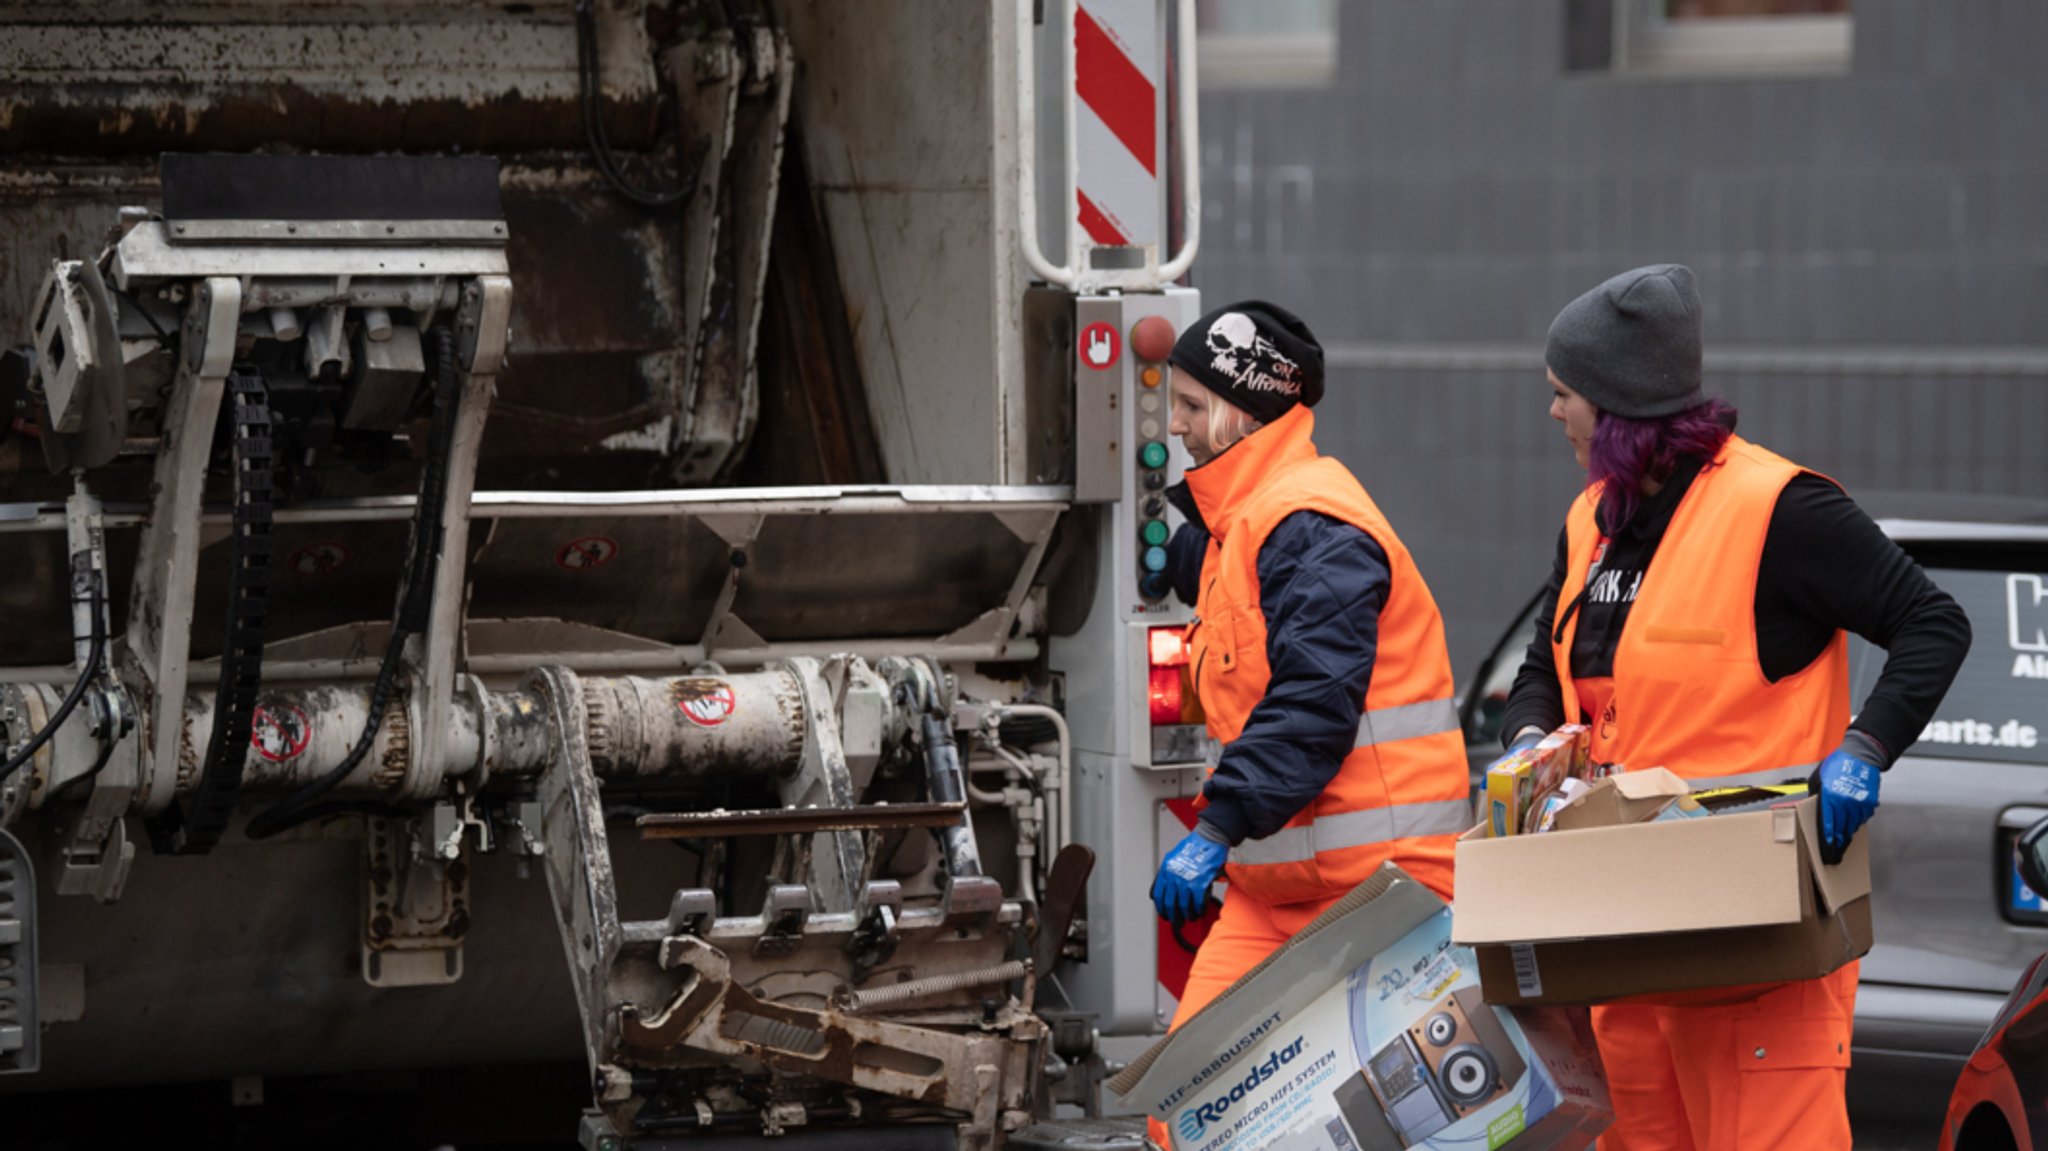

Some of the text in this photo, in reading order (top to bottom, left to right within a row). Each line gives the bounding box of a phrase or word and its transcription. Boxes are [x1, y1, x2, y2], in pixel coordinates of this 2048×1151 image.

[1195, 1035, 1305, 1129] Roadstar
[1198, 1128, 1233, 1151] TEREO
[1234, 1101, 1269, 1133] MICRO
[1270, 1081, 1294, 1105] HIFI
[1295, 1049, 1336, 1086] SYSTEM
